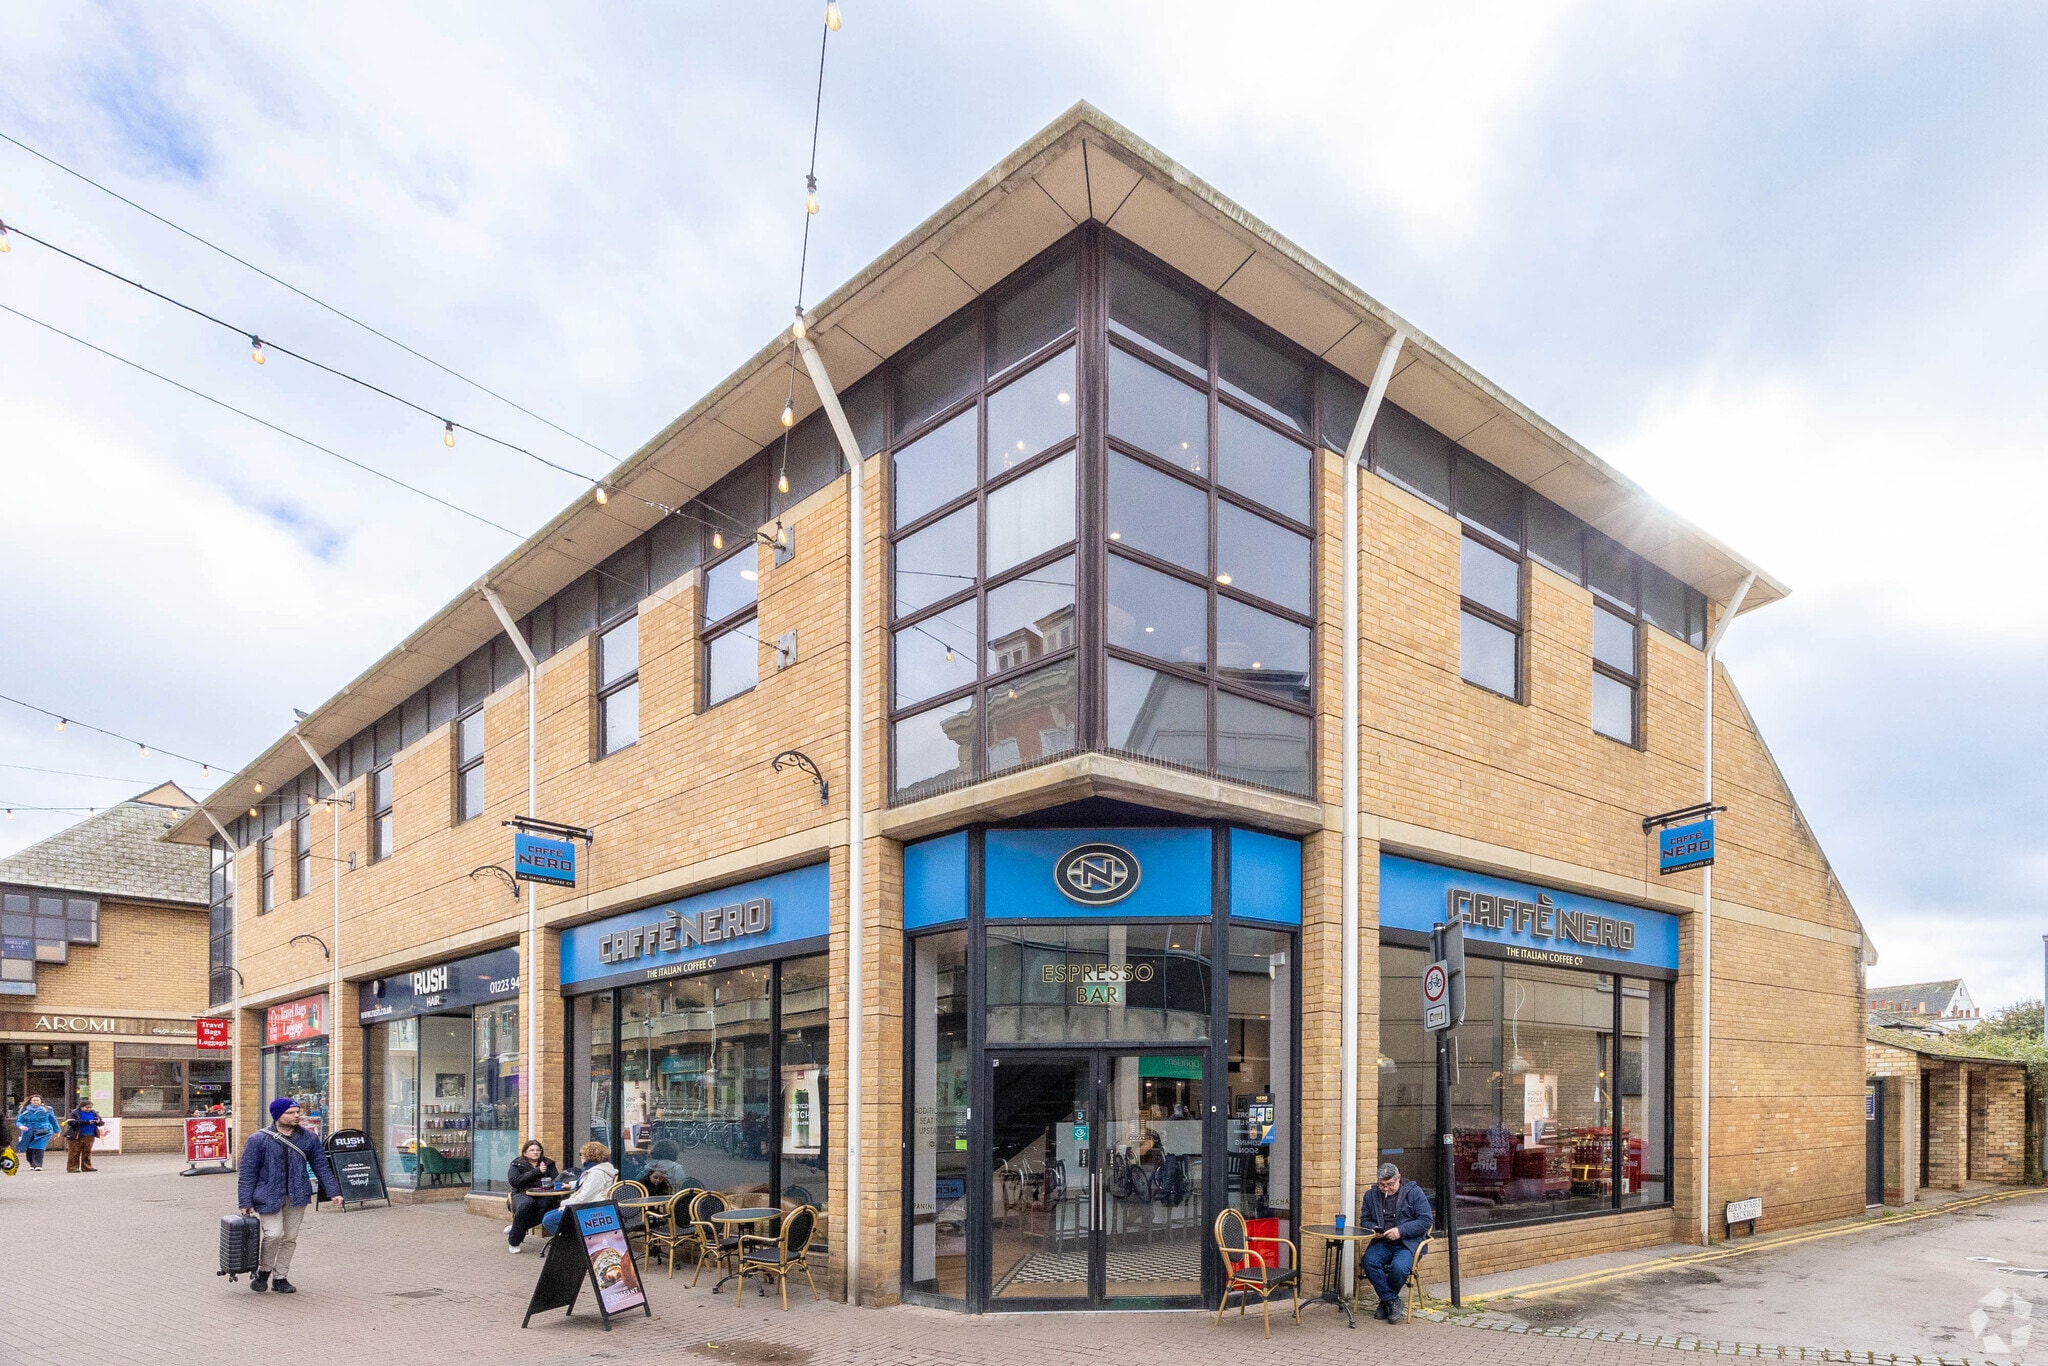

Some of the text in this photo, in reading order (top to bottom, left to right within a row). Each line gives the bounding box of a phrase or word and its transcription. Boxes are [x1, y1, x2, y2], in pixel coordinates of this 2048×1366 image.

[1662, 840, 1710, 859] NERO
[519, 854, 572, 872] NERO
[682, 898, 771, 947] NERO
[1556, 908, 1635, 950] NERO
[1506, 946, 1520, 957] THE
[1521, 948, 1548, 962] ITALIAN
[1549, 953, 1574, 965] COFFEE
[647, 969, 658, 979] THE
[658, 965, 682, 977] ITALIAN
[683, 961, 707, 972] COFFEE
[1042, 963, 1154, 983] ESPRESSO
[414, 966, 448, 995] RUSH
[490, 979, 509, 994] 01223
[426, 996, 440, 1007] HAIR
[1077, 985, 1118, 1004] BAR
[361, 1004, 392, 1019] www.rush.co.uk
[35, 1016, 116, 1032] AROMI
[283, 1022, 303, 1038] Luggage
[335, 1137, 365, 1145] RUSH
[1728, 1199, 1760, 1212] EDEN STREET
[584, 1216, 612, 1229] NERO
[1733, 1209, 1757, 1220] BACKWAY
